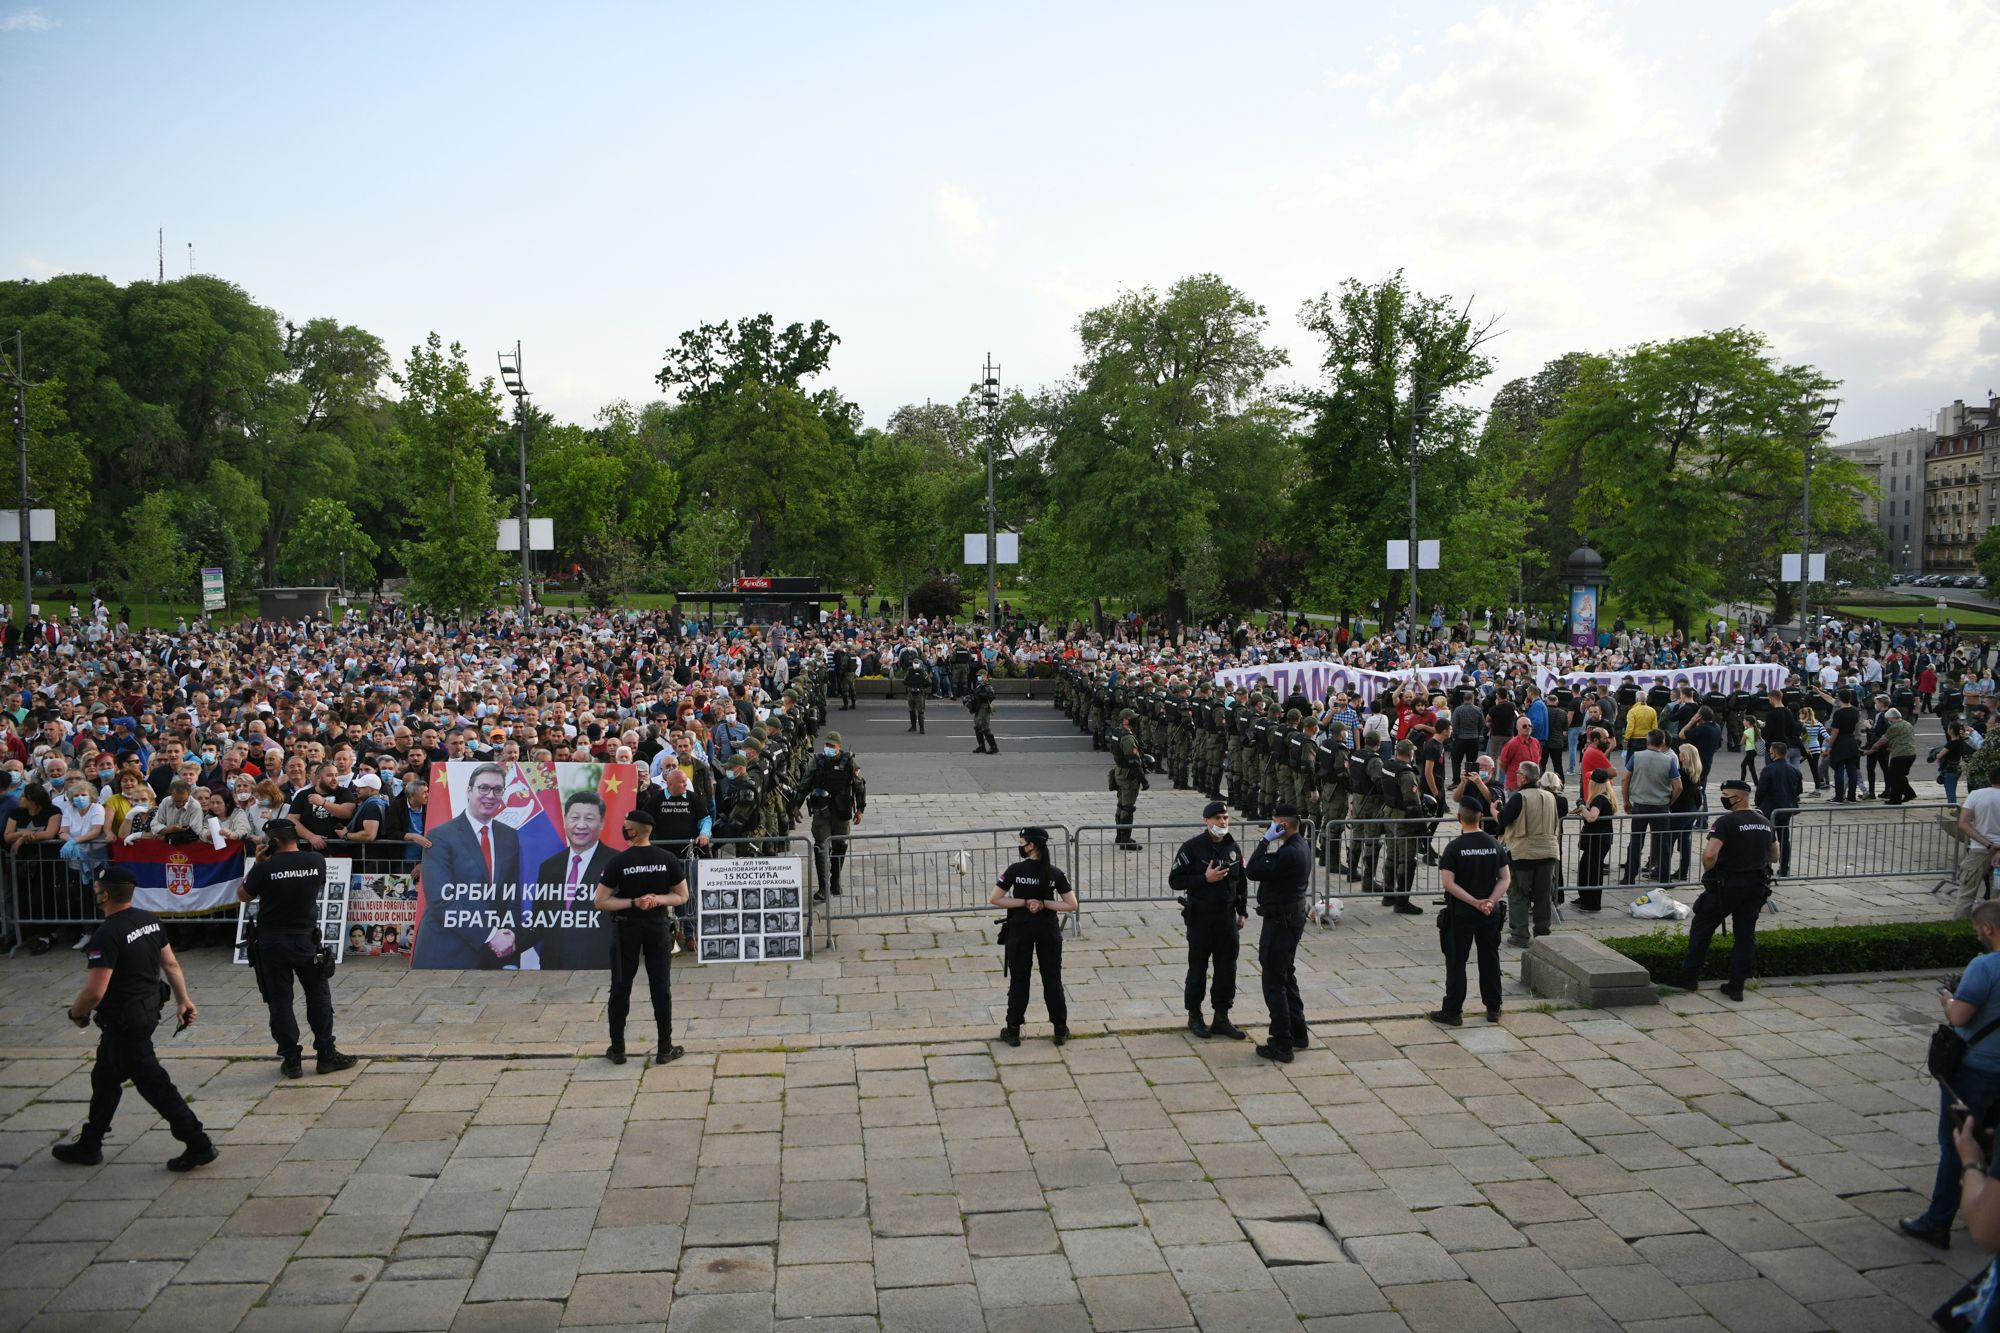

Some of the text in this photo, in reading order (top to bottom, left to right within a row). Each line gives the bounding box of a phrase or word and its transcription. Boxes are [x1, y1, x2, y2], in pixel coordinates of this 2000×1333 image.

[1739, 824, 1771, 832] ПОЛИЦИЈА
[1461, 848, 1497, 856] ПОЛИЦИЈА
[271, 868, 318, 881] ПОЛИЦИЈА
[623, 865, 667, 876] ПОЛИЦИЈА
[1015, 876, 1056, 887] ПОЛИЈА
[441, 883, 597, 901] СРБИ И КИНЕЗИ
[354, 901, 365, 910] WILL
[366, 901, 382, 910] NEVER
[384, 901, 405, 910] FORGIVE
[406, 901, 416, 910] YOU
[375, 912, 389, 921] OUR
[521, 910, 601, 928] ЗАУВЕК
[127, 923, 160, 943] ПОЛИЦИЈА
